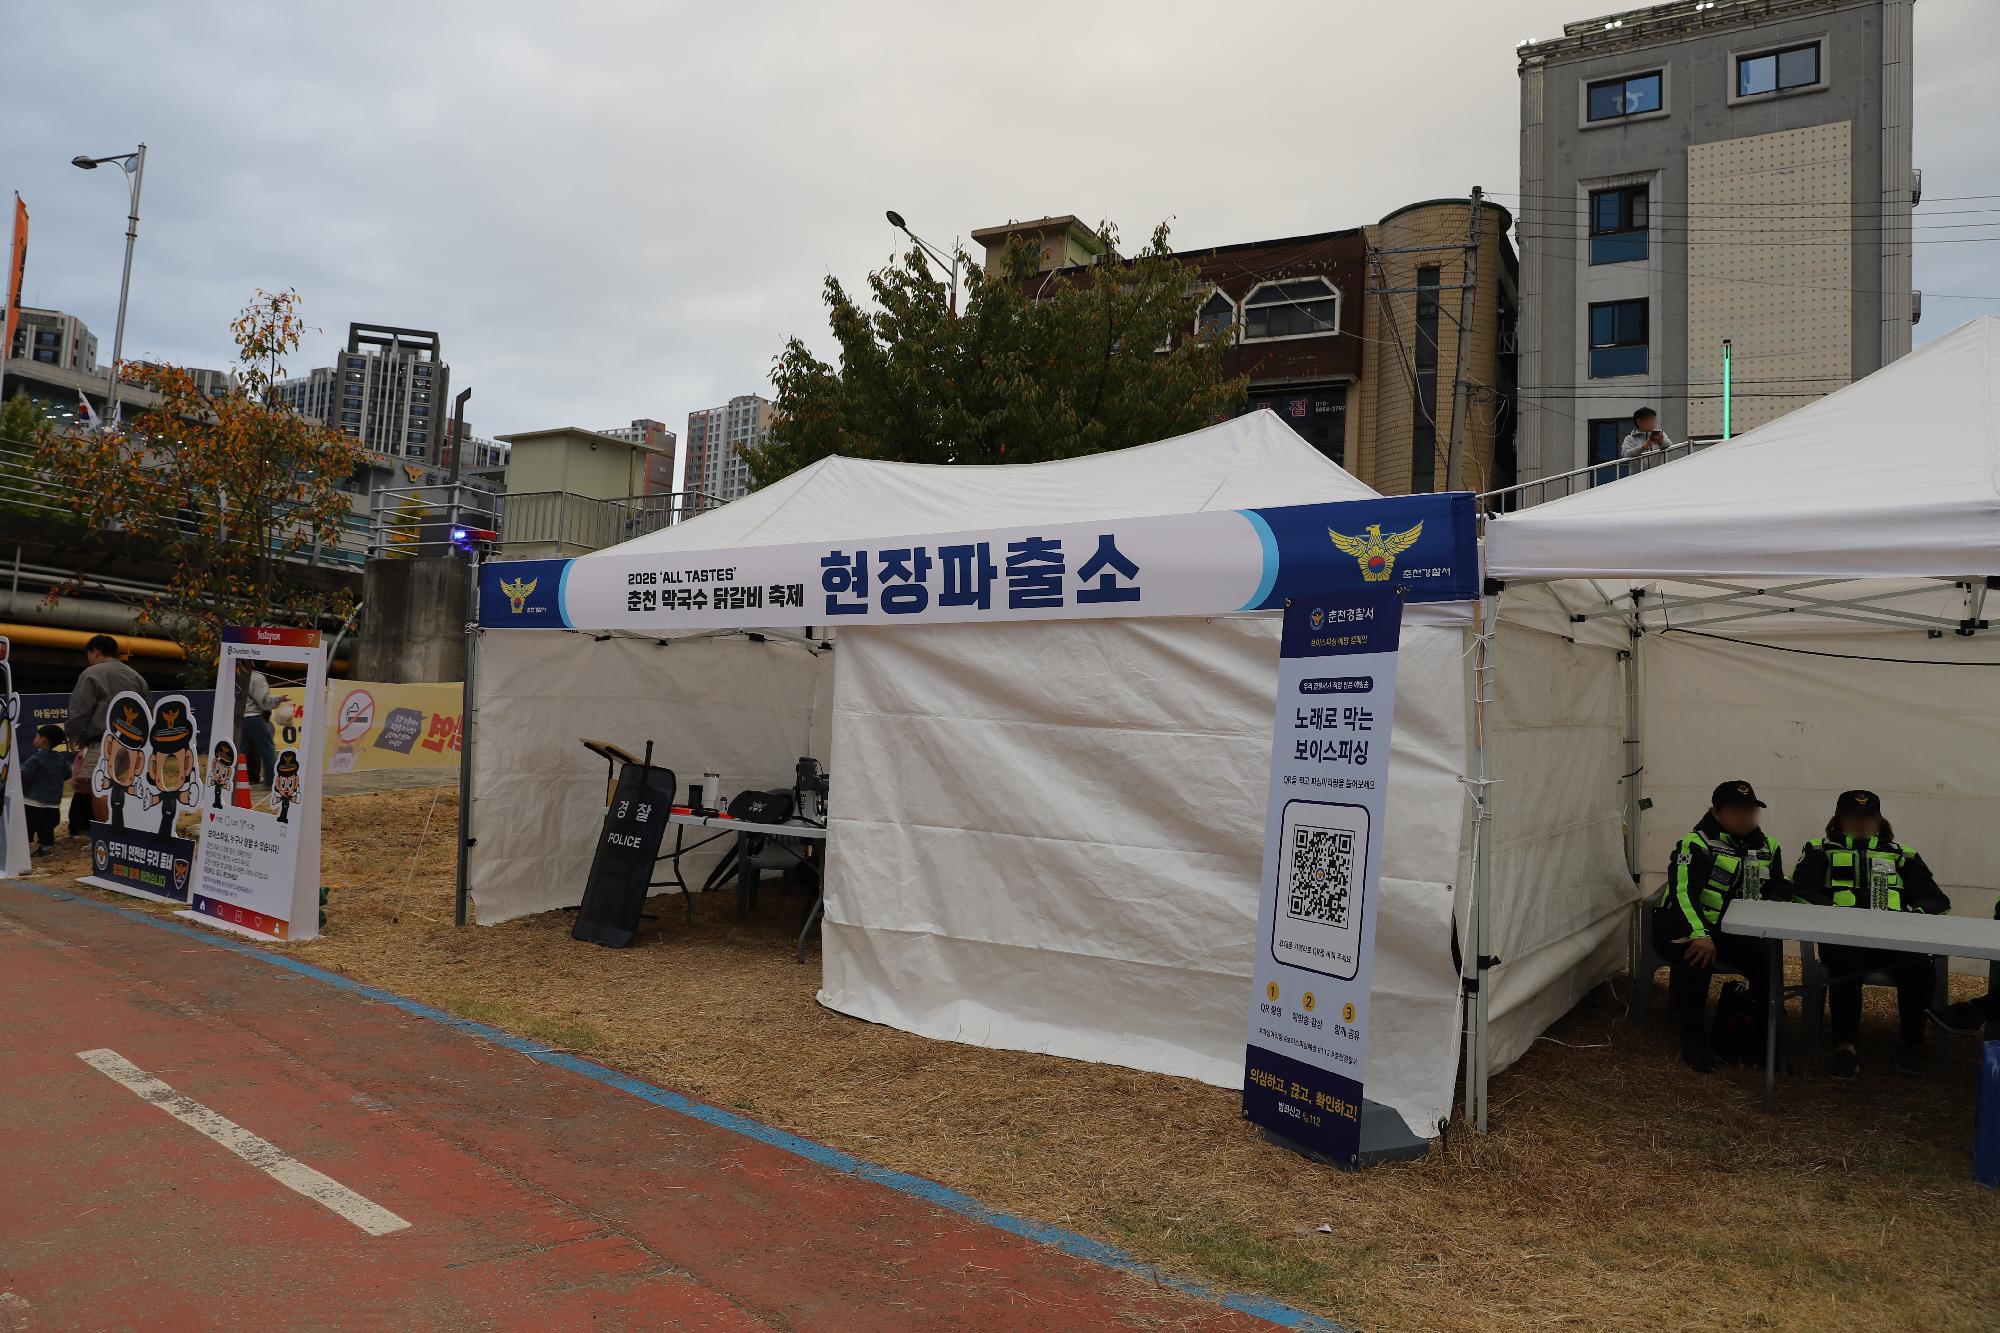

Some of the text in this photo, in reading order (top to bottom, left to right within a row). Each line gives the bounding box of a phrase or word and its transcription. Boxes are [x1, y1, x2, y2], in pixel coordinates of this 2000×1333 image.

[628, 572, 657, 585] 2026
[820, 533, 1141, 615] 현장파출소
[1402, 567, 1451, 579] 춘천경찰서
[627, 583, 804, 612] 춘천 막국수 닭갈비 축제
[1328, 607, 1374, 624] 춘천경찰서
[1294, 706, 1374, 732] 노래로 막는
[1293, 739, 1369, 766] 보이스피싱
[607, 832, 642, 849] POLICE
[109, 841, 174, 871] 모두가 안전한 우리 동네
[1260, 1002, 1270, 1014] QR
[1305, 995, 1313, 1009] 2
[1345, 1006, 1353, 1020] 3
[1348, 1028, 1361, 1042] 공유
[1249, 1068, 1358, 1123] 의심하고, 끊고, 확인하고!
